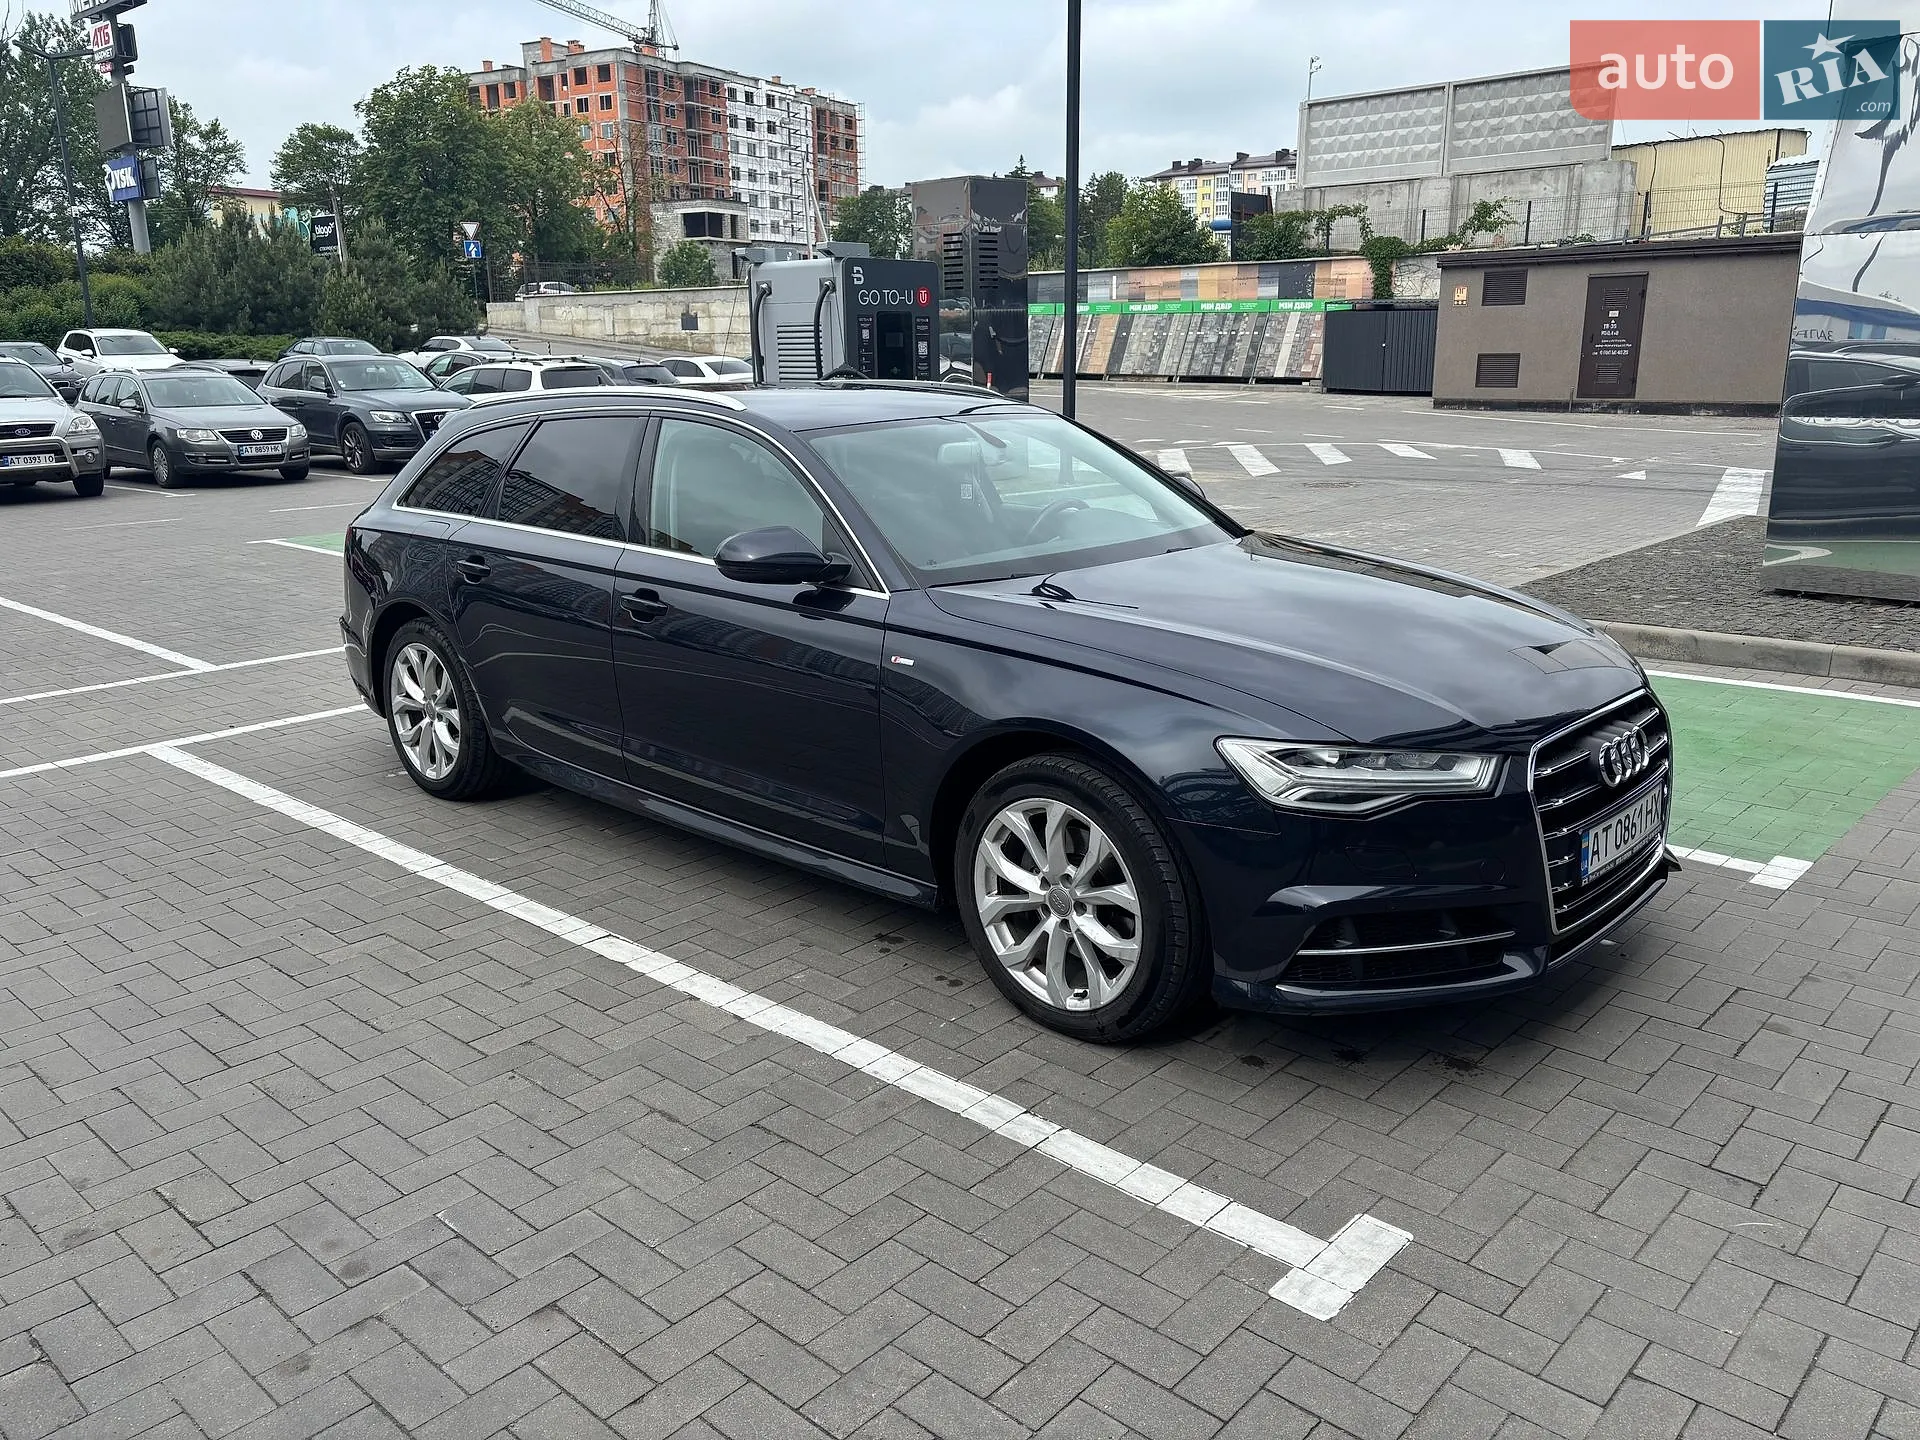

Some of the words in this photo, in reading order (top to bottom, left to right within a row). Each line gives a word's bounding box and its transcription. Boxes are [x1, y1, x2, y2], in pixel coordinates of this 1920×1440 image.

[110, 166, 137, 190] JYSK
[858, 289, 880, 305] GO
[882, 289, 914, 305] TO-U
[1215, 302, 1233, 311] ДВІР
[1294, 302, 1313, 311] ДВІР
[245, 446, 254, 454] AT
[9, 456, 21, 465] AT
[23, 455, 41, 464] 0393
[1590, 823, 1613, 867] AT
[1614, 803, 1644, 850] 0861
[1645, 789, 1661, 832] HX
